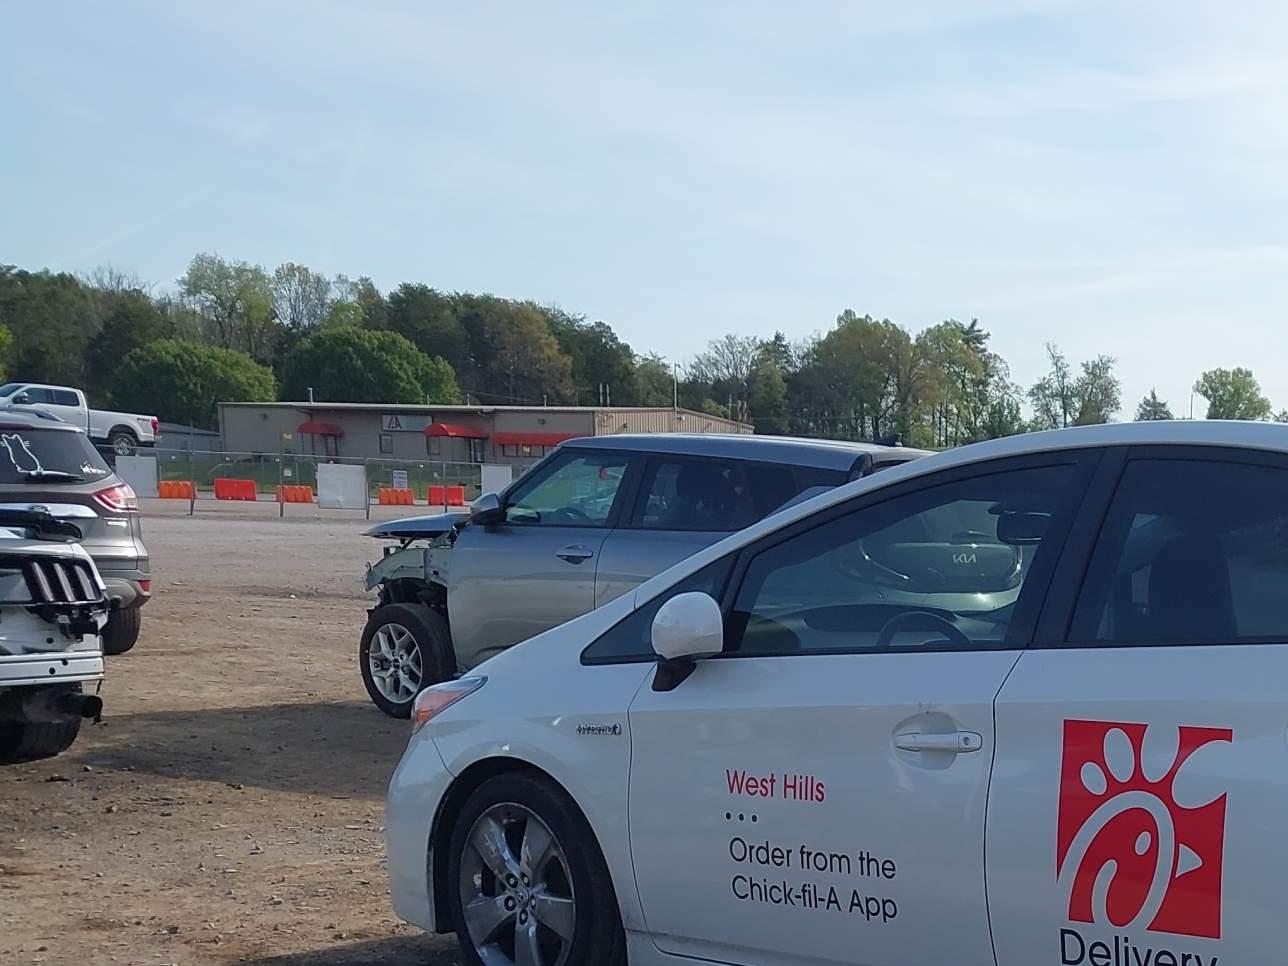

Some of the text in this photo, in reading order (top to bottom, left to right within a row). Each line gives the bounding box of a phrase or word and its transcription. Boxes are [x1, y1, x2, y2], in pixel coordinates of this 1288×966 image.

[952, 552, 977, 565] KIA
[726, 769, 825, 802] West Hills
[729, 837, 897, 880] Order from the
[732, 875, 898, 923] Chick-fil-A App
